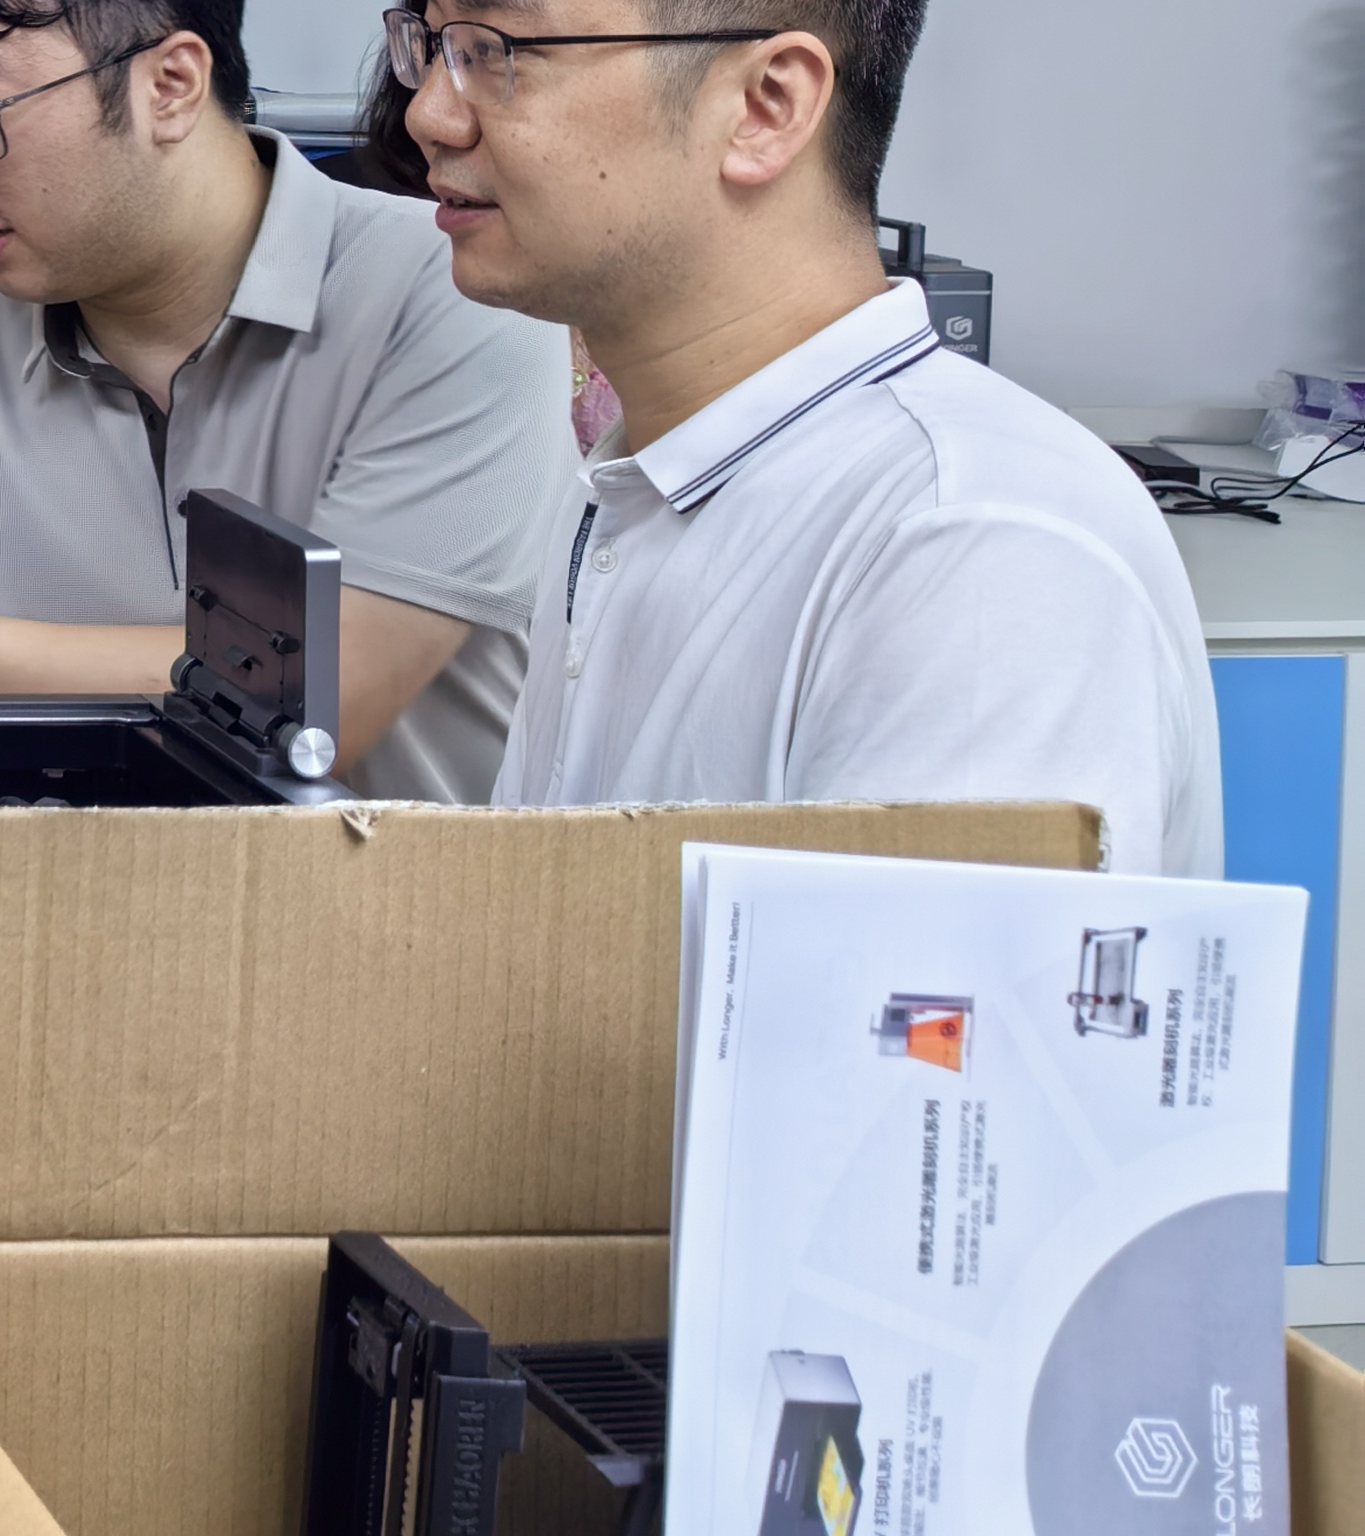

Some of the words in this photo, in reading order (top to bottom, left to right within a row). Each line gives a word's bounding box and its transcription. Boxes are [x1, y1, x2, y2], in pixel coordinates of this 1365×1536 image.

[718, 1033, 729, 1060] With
[726, 953, 737, 984] Make
[1160, 988, 1183, 1107] 激光雕刻机系列
[1211, 1384, 1236, 1536] LONGER
